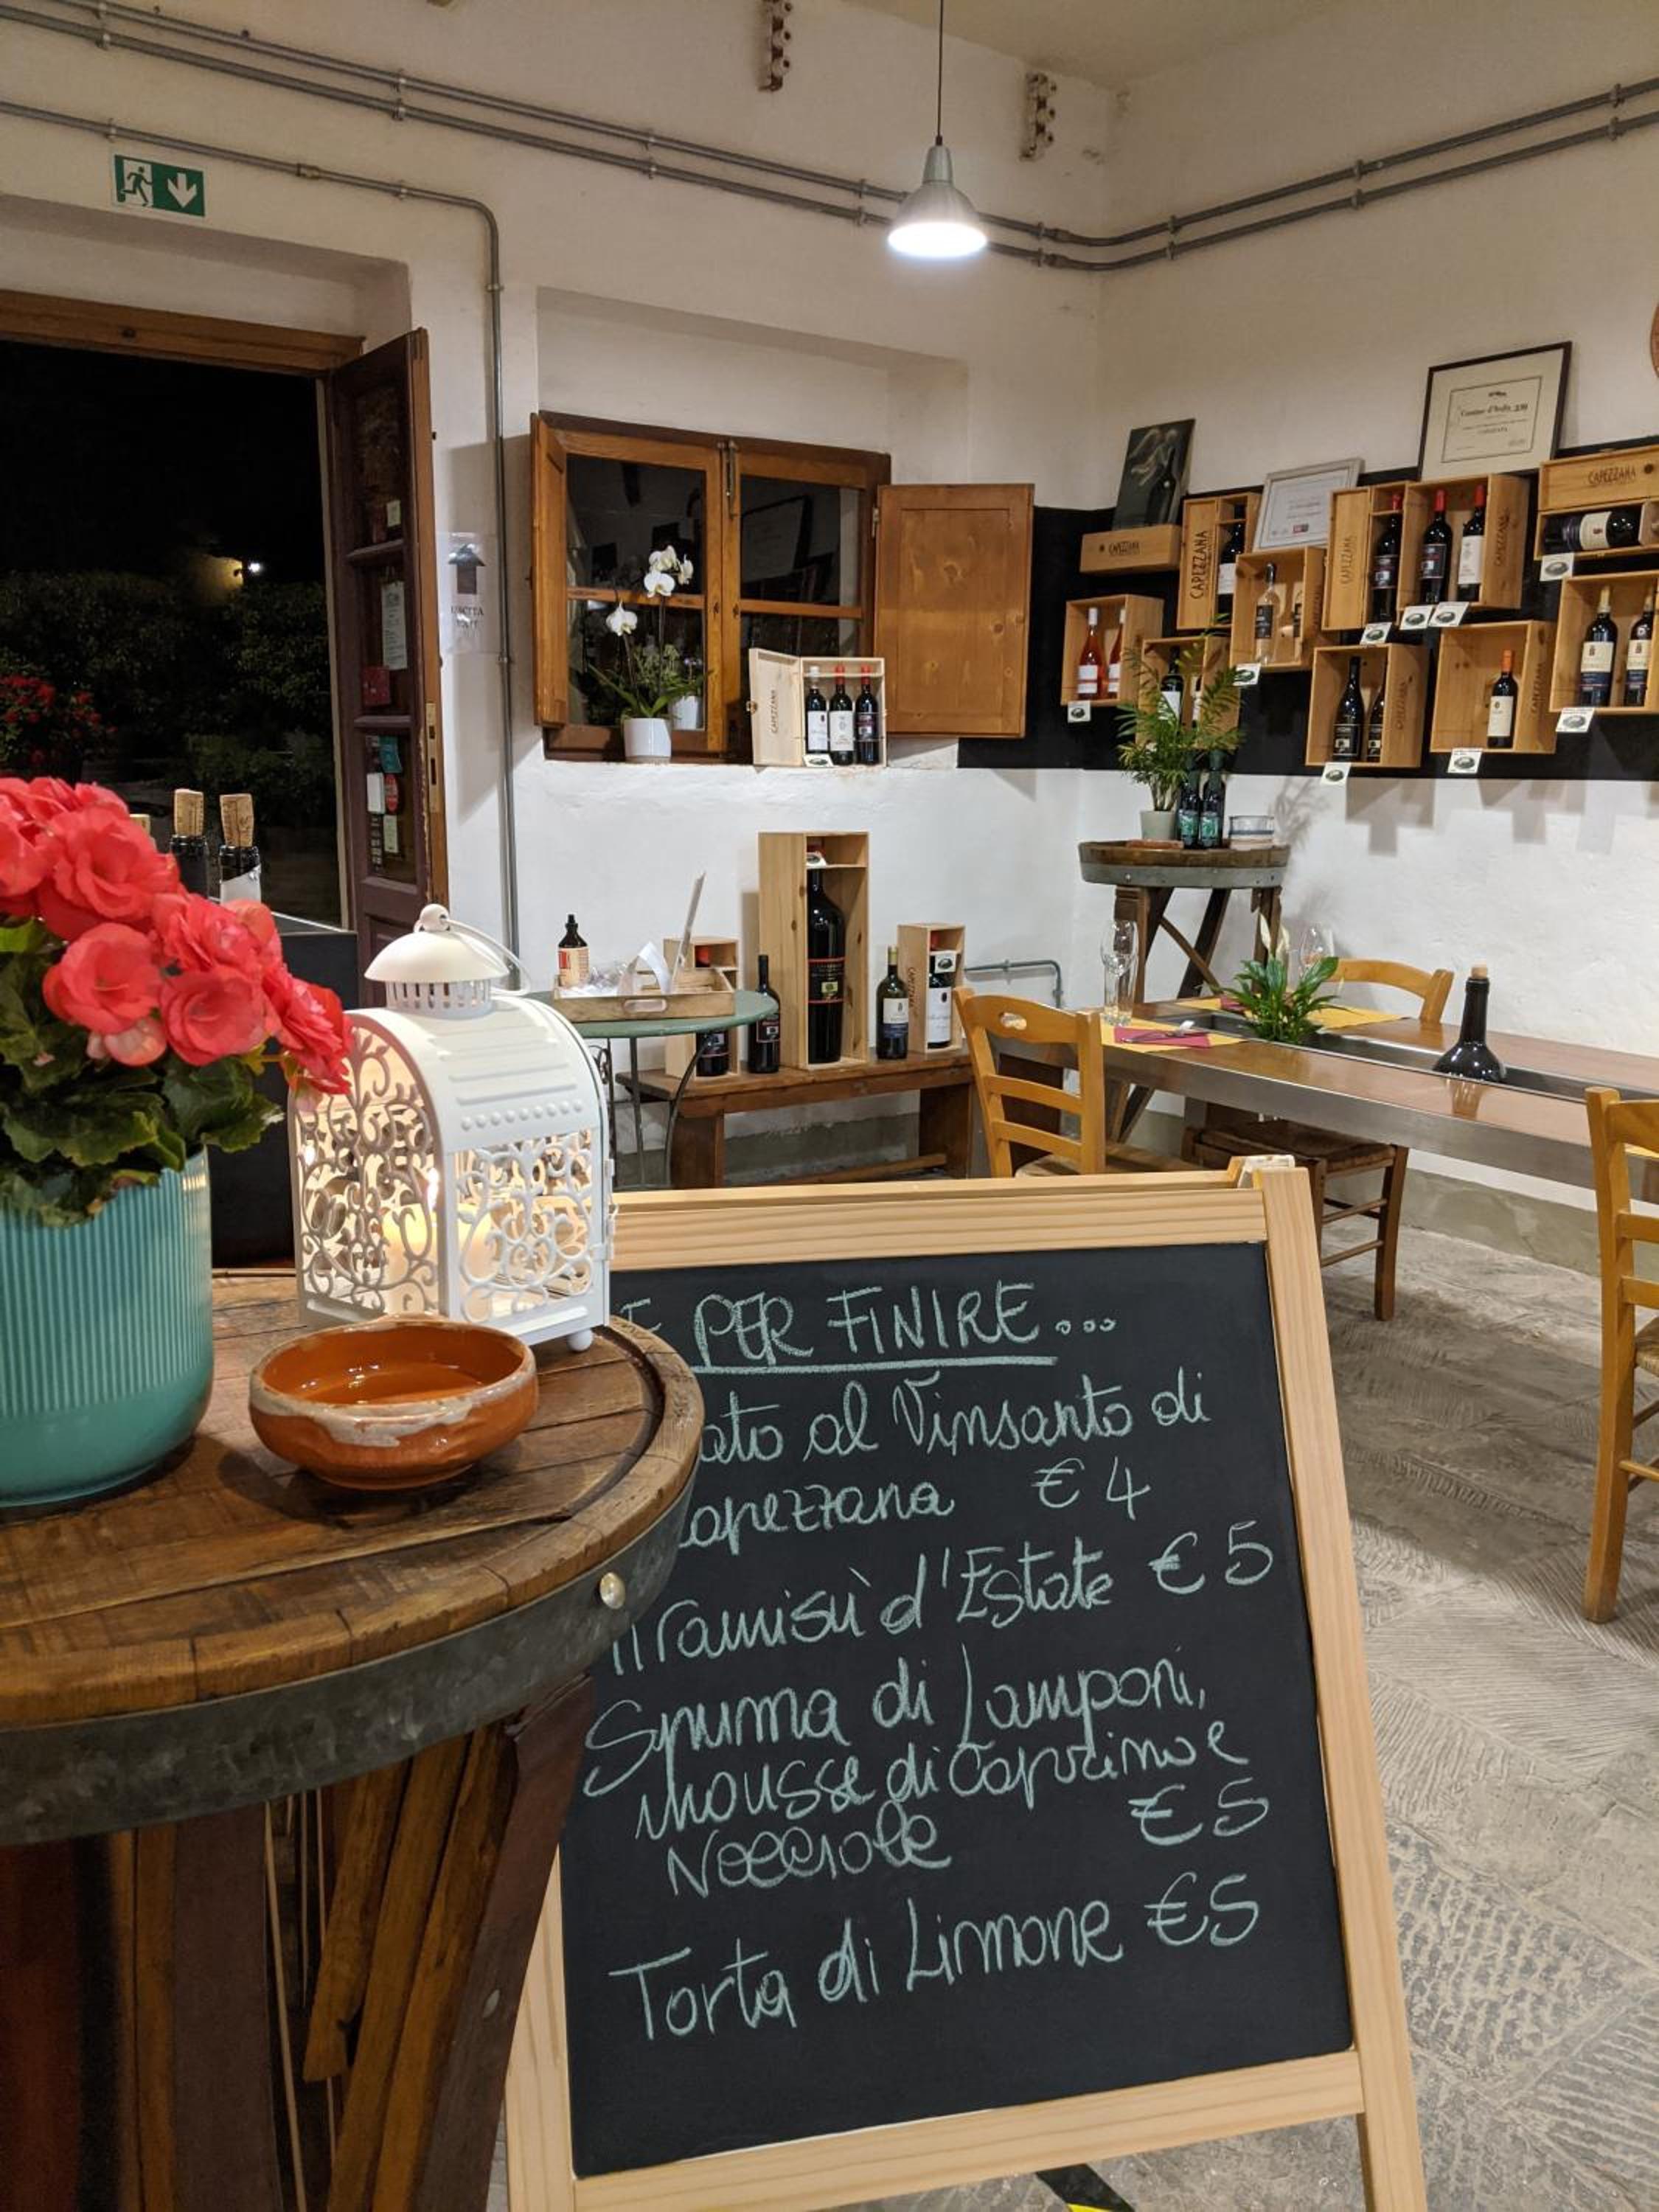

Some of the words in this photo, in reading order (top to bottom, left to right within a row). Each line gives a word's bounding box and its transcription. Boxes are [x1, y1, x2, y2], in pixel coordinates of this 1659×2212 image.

[1191, 529, 1208, 599] CAPEZZANA
[695, 1292, 814, 1366] PER
[700, 1391, 785, 1464] ato
[803, 1380, 879, 1463] al
[893, 1370, 1133, 1456] Vinsanto
[1152, 1366, 1212, 1426] di
[679, 1481, 956, 1556] apezzana
[1107, 1456, 1151, 1520] 4
[880, 1537, 1114, 1635] d'Estate
[1225, 1520, 1274, 1586] 5
[872, 1657, 935, 1728] di
[886, 1742, 939, 1803] di
[1208, 1720, 1249, 1764] e
[608, 1938, 798, 2040] Torta
[818, 1917, 880, 2003] di
[906, 1896, 1124, 1992] Limone
